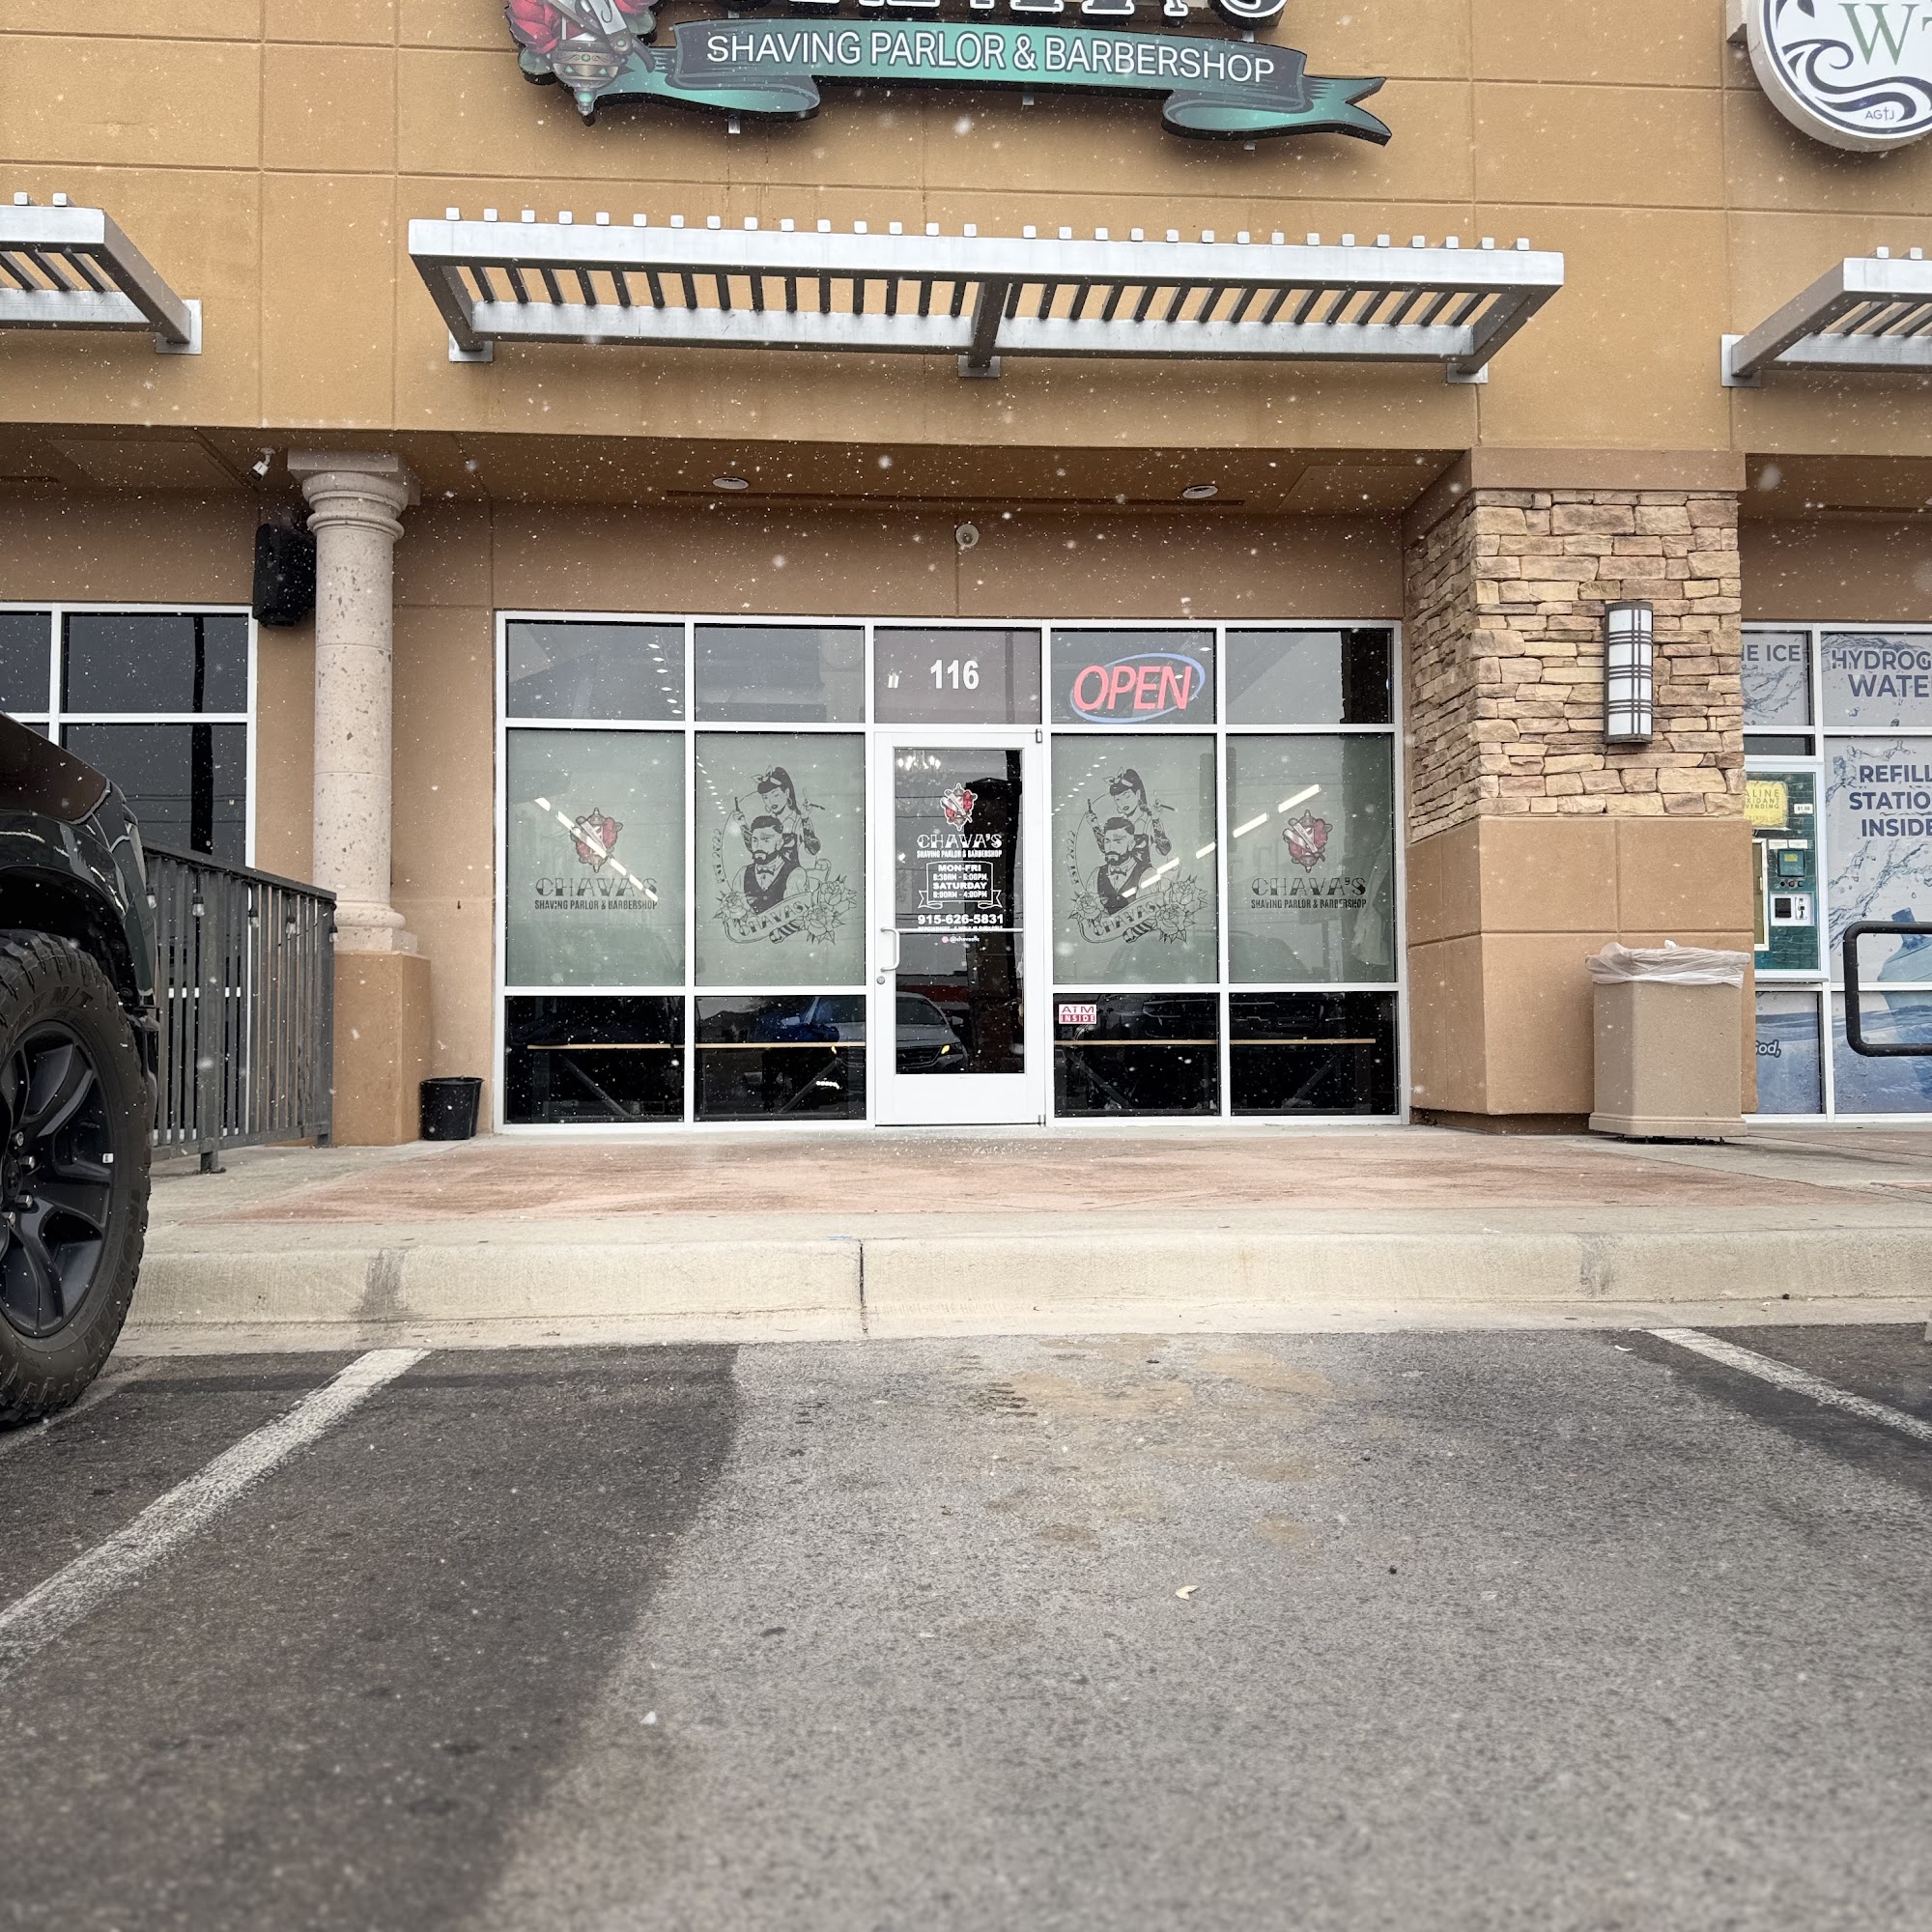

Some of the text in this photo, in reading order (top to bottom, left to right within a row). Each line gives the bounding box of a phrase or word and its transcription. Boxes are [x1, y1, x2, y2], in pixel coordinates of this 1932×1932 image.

[706, 31, 1275, 83] SHAVING PARLOR & BARBERSHOP
[1767, 644, 1801, 662] ICE
[1832, 650, 1932, 670] HYDROG
[930, 660, 980, 690] 116
[1073, 665, 1193, 711] OPEN
[1849, 791, 1931, 810] STATIO
[917, 834, 1003, 848] CHAVA'S
[917, 849, 940, 859] SHAVING
[941, 849, 961, 859] PARLOR
[967, 849, 1003, 859] BARBERSHOP
[938, 864, 982, 872] MON-FRI
[1251, 877, 1366, 896] CHAVA'S
[535, 899, 658, 910] SHAVING PARLOR & BARBERSHOP
[1251, 899, 1367, 909] SHAVING PARLOR & BARBERSHOP
[918, 913, 1004, 924] 915-626-5831
